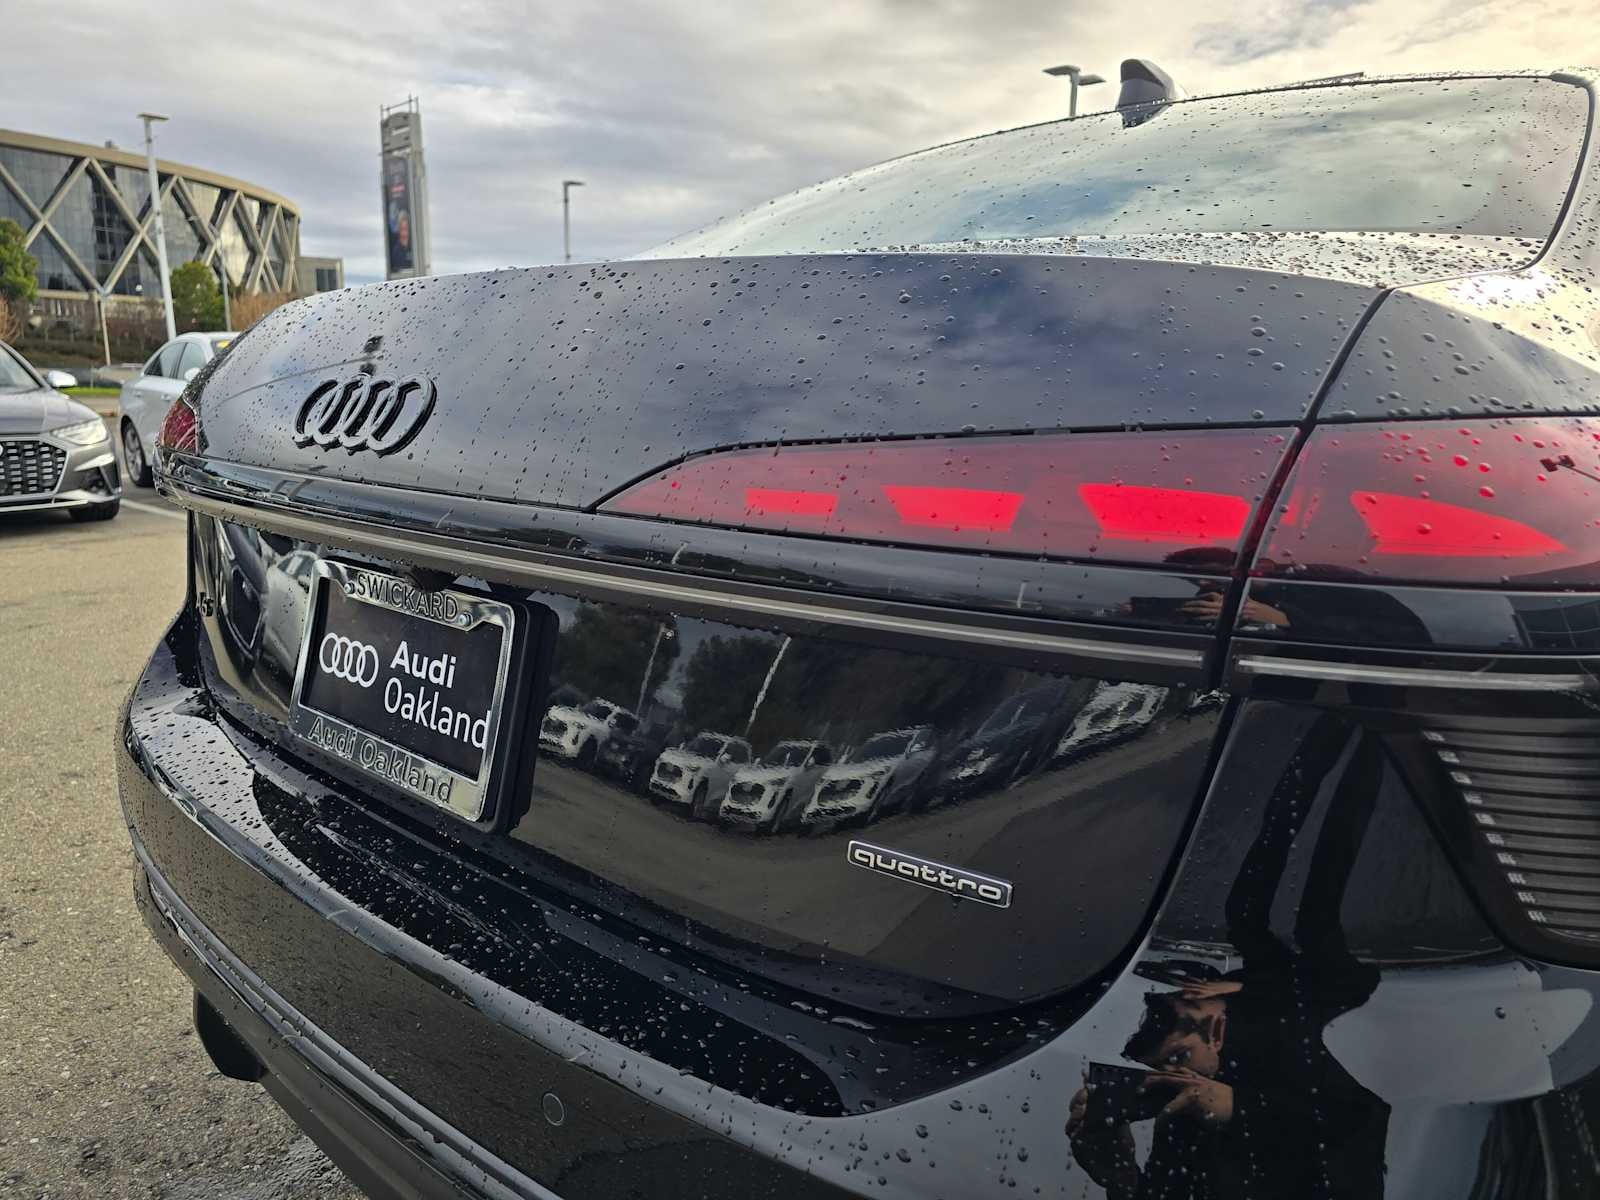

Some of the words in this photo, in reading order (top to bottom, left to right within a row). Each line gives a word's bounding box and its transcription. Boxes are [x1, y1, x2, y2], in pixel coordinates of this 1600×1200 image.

[356, 572, 458, 622] SWICKARD
[390, 641, 457, 688] Audi
[384, 677, 491, 750] Oakland
[308, 716, 358, 760] Audi
[360, 737, 454, 803] Oakland
[854, 848, 1002, 900] quattro
